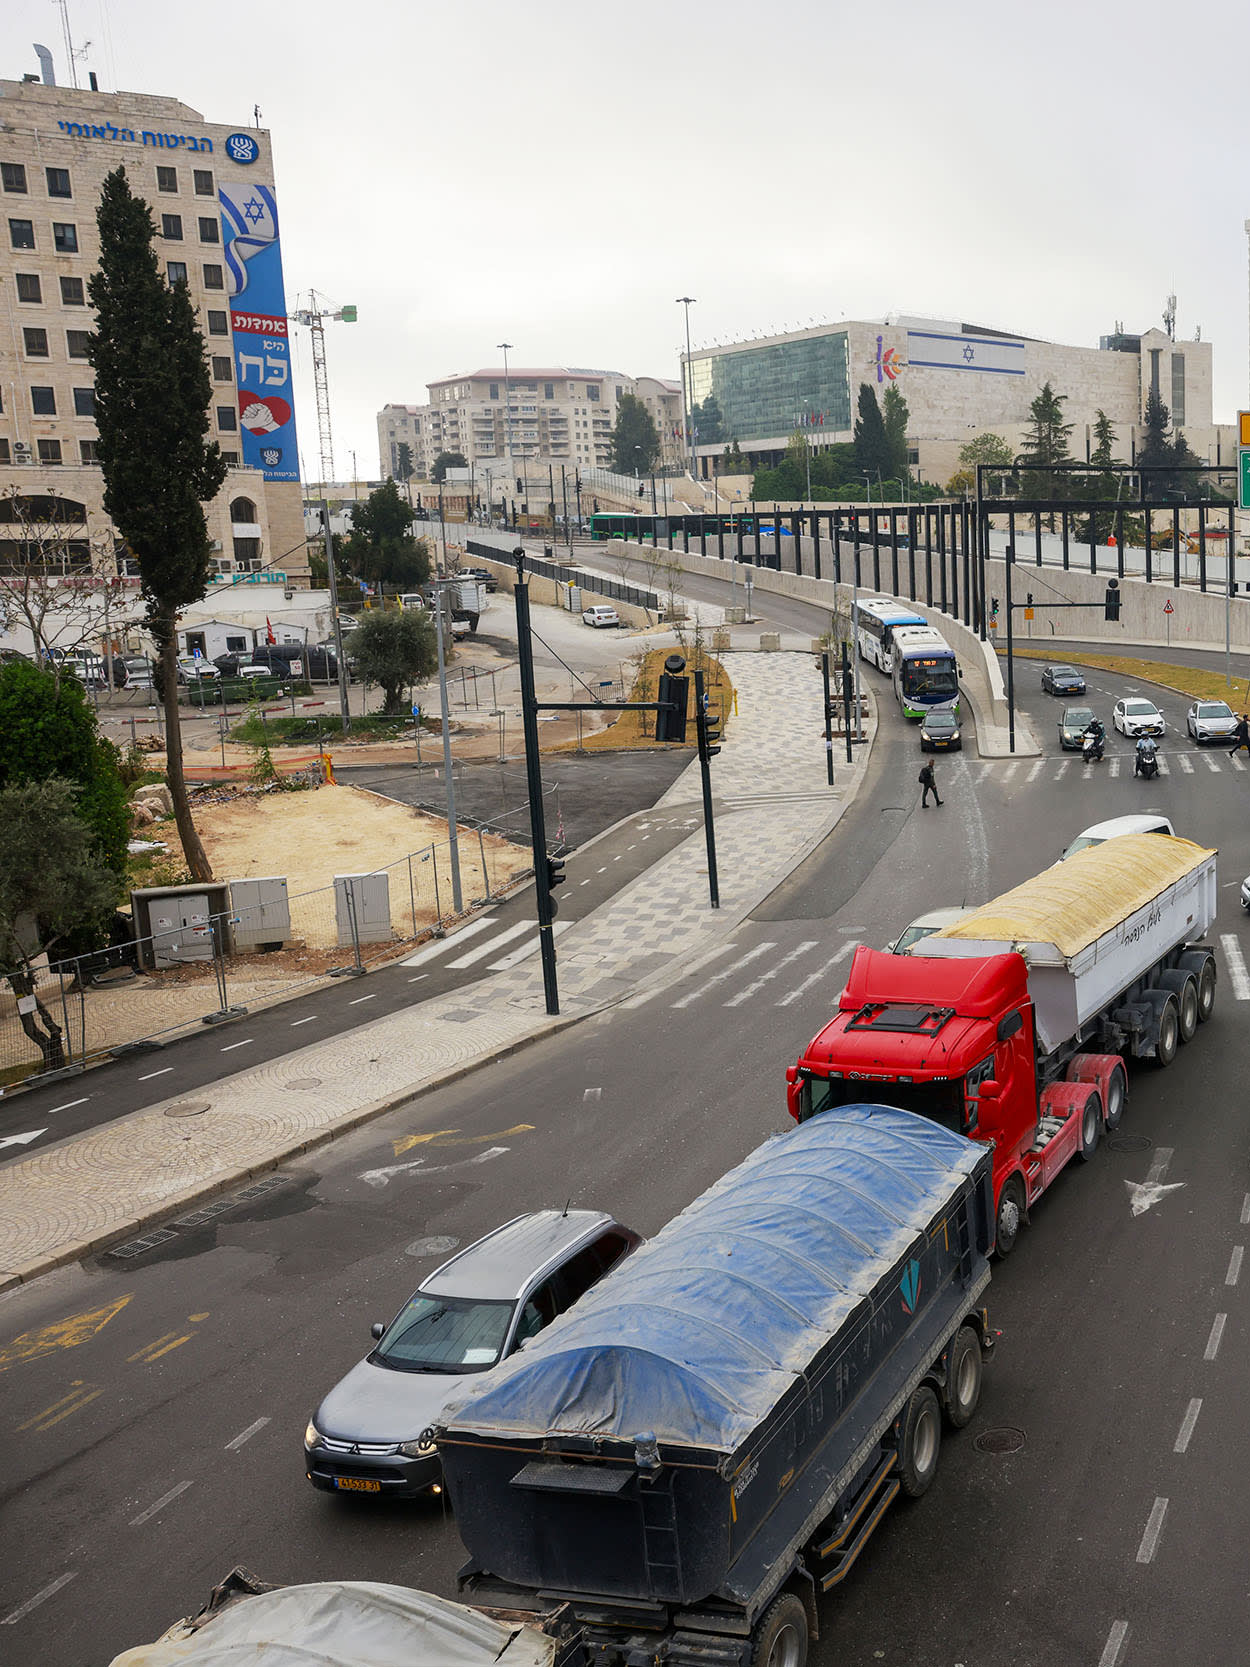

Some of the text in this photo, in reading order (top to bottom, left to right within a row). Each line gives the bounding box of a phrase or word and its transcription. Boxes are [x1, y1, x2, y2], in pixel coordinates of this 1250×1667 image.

[57, 121, 213, 152] הביטוח הלאומי
[234, 315, 286, 333] אחדות
[262, 339, 286, 352] היא
